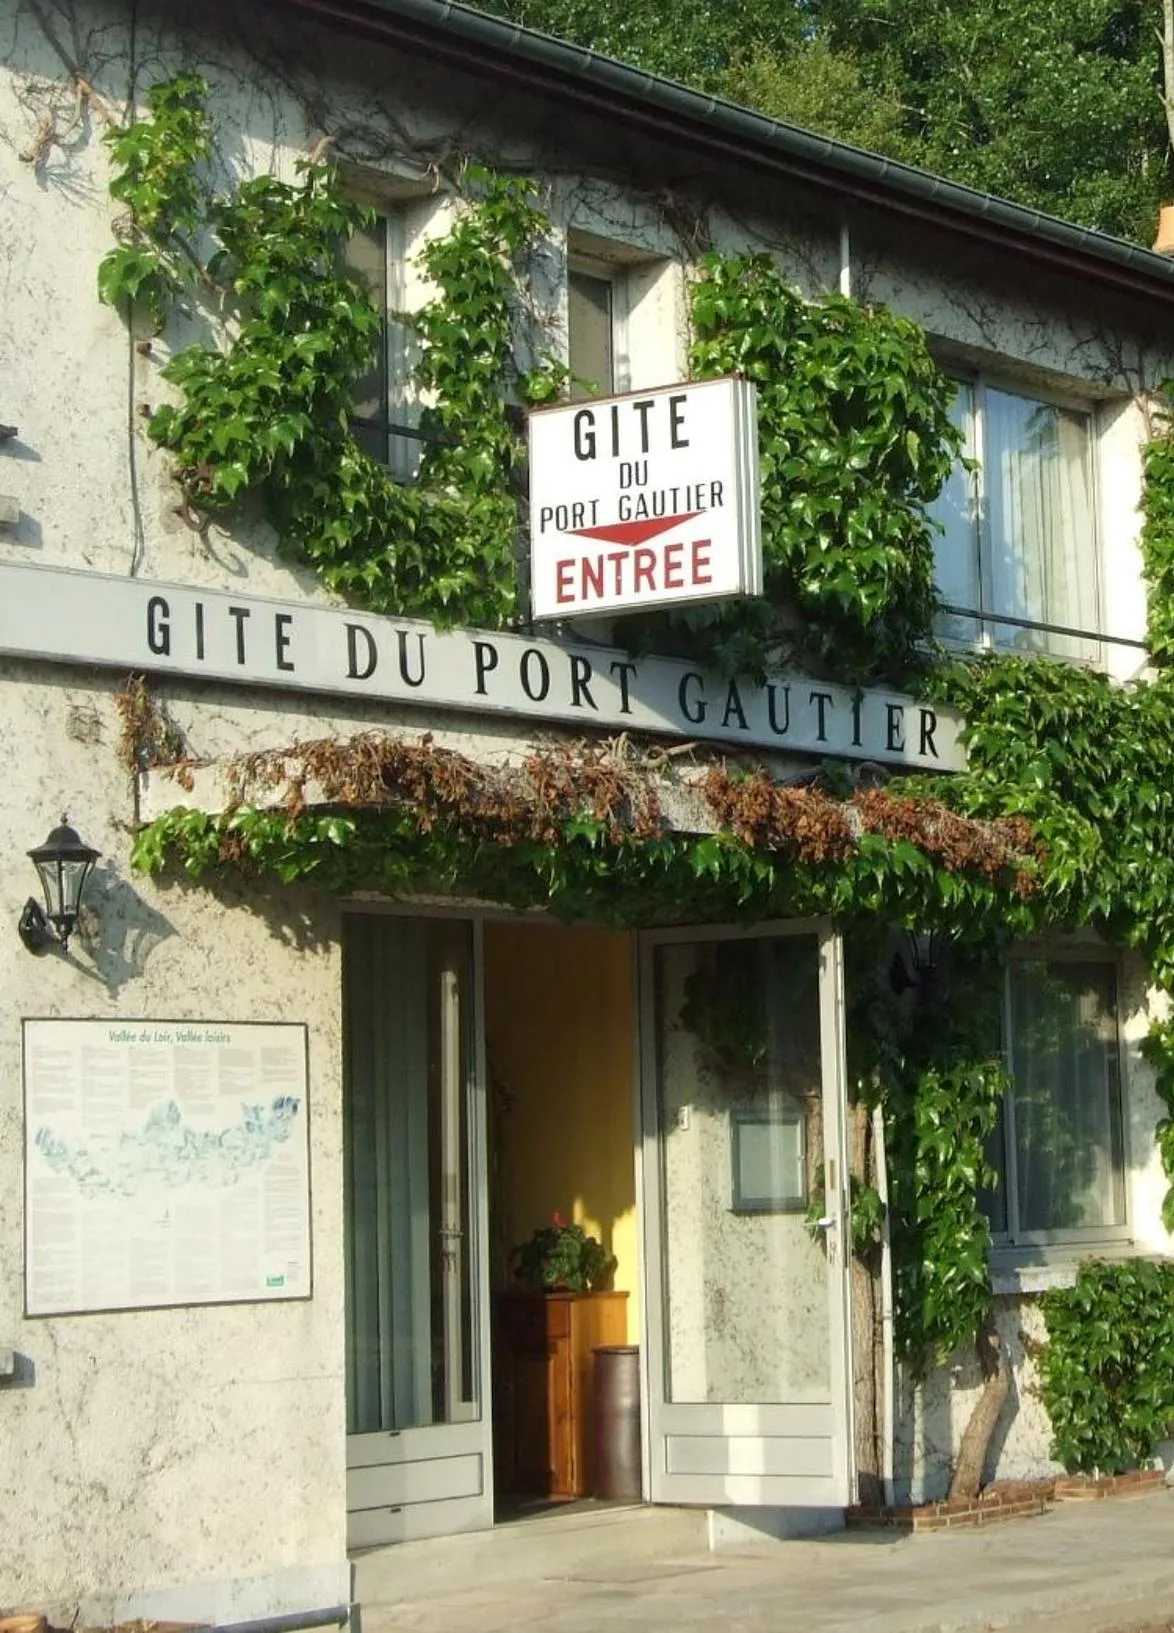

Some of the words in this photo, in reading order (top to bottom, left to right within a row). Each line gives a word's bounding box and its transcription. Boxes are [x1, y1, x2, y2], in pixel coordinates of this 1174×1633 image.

[573, 394, 690, 461] GITE
[540, 498, 600, 534] PORT
[618, 480, 724, 522] GAUTIER
[619, 460, 648, 489] DU
[556, 538, 713, 604] ENTREE
[146, 595, 295, 672] GITE
[344, 622, 427, 687] DU
[472, 641, 638, 714] PORT
[678, 671, 940, 759] GAUTIER
